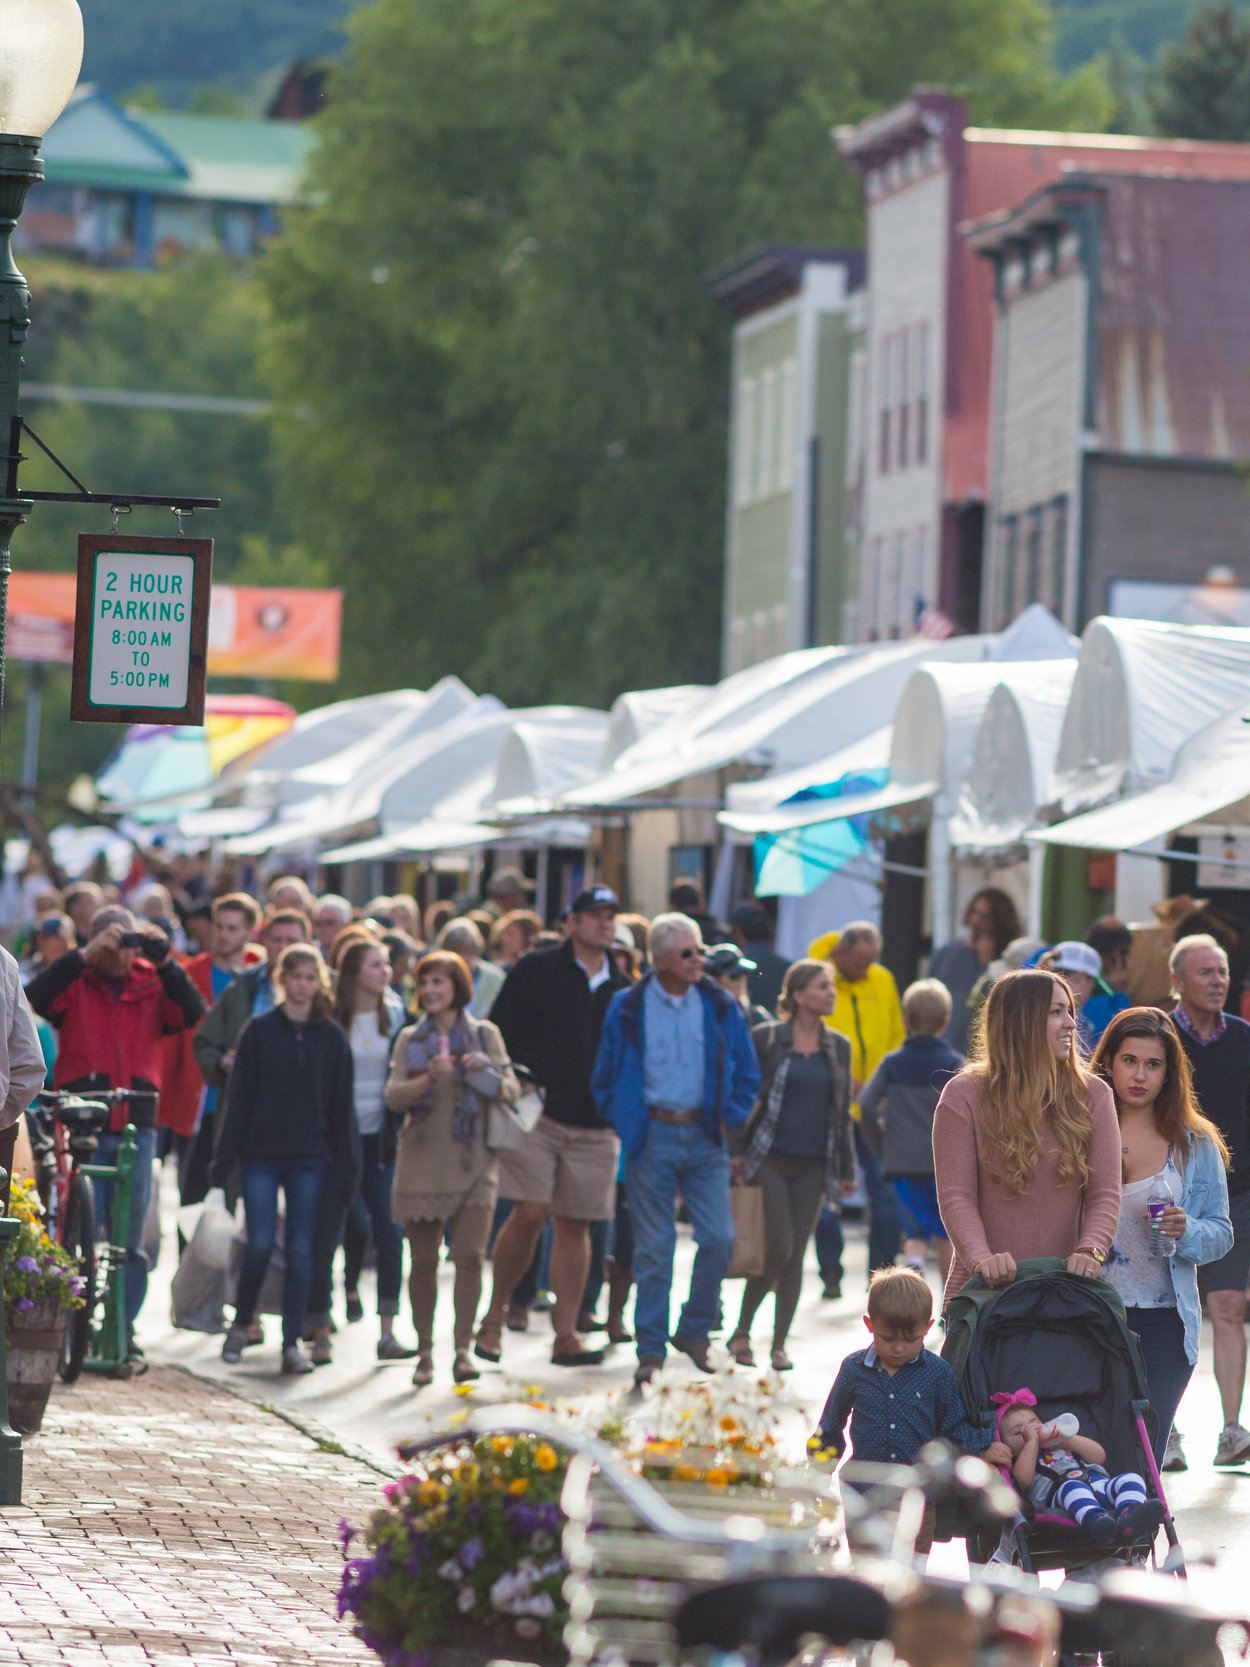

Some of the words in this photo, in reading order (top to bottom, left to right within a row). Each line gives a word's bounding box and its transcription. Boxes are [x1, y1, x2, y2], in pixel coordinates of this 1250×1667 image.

[106, 572, 117, 591] 2
[130, 573, 182, 594] HOUR
[101, 599, 184, 622] PARKING
[132, 651, 149, 666] TO
